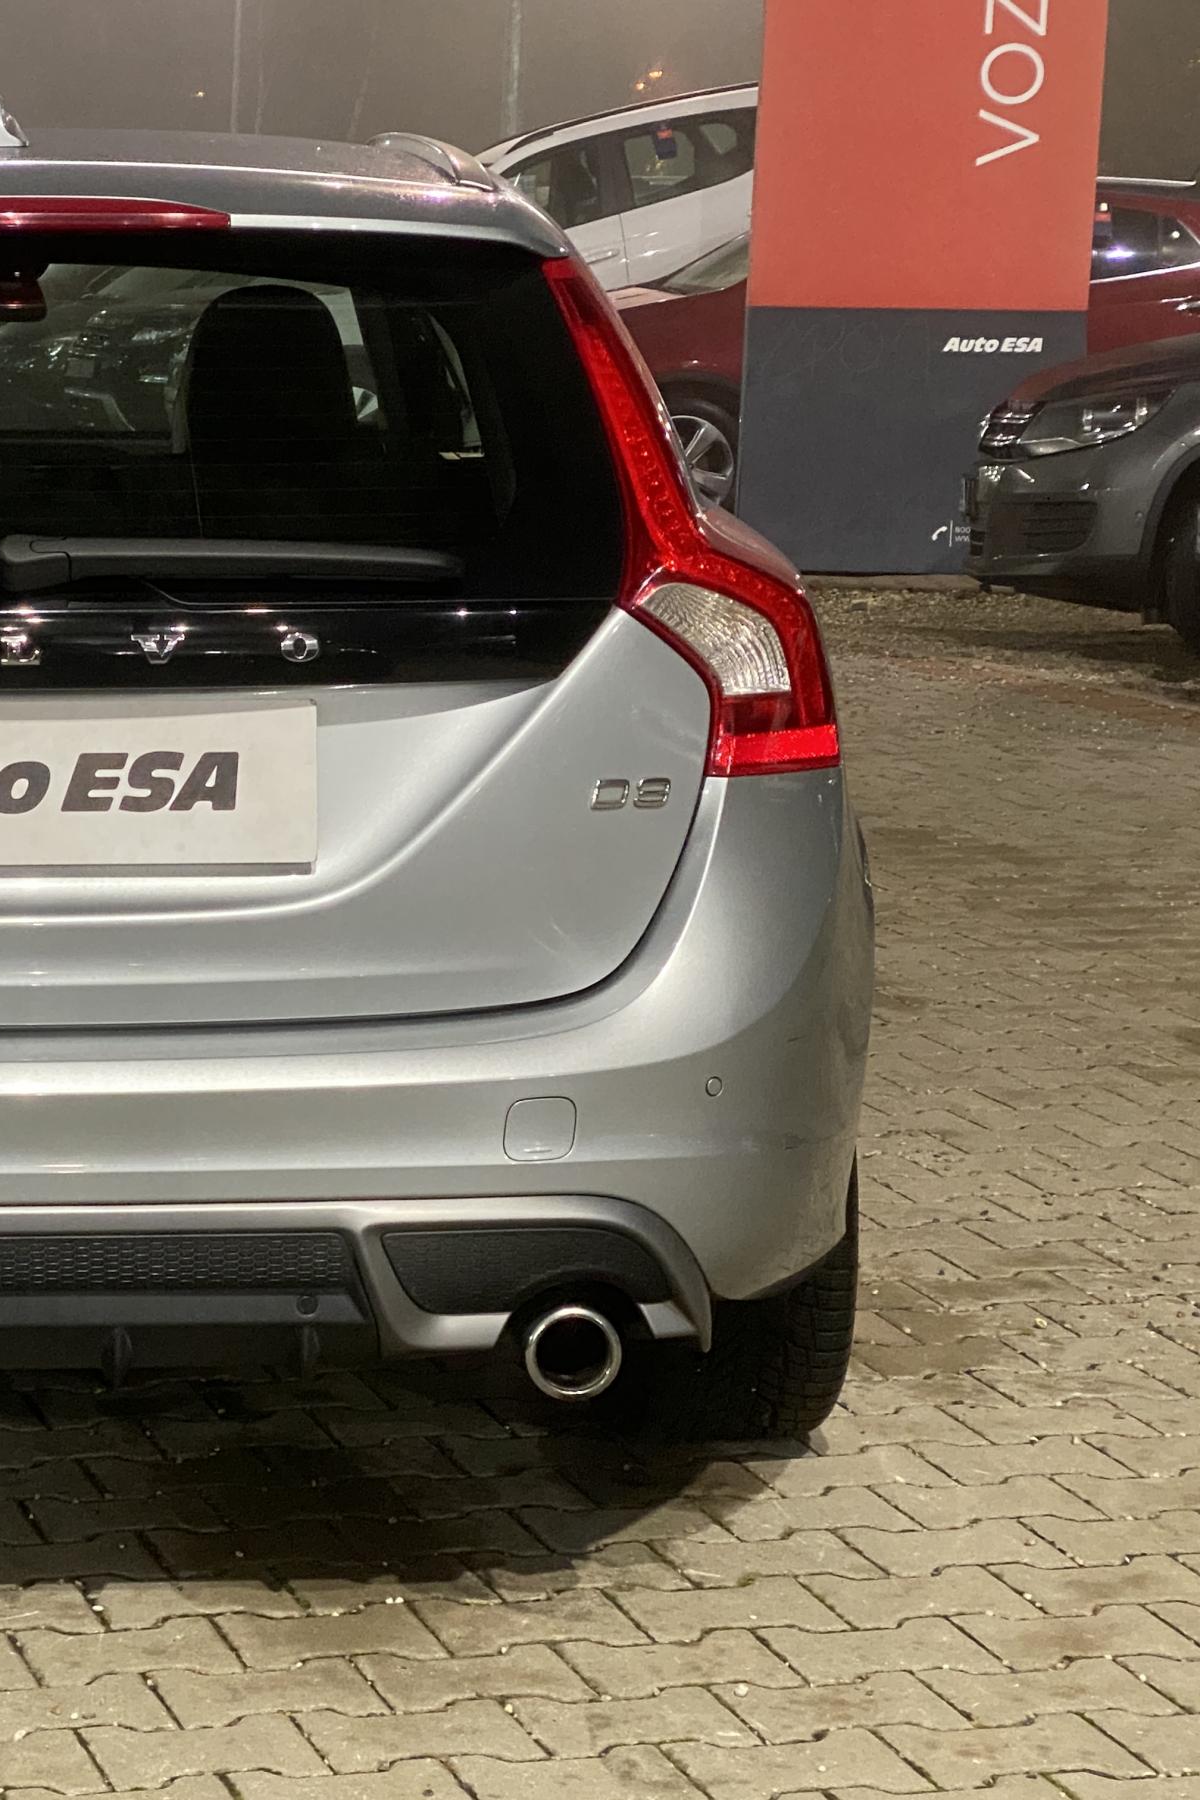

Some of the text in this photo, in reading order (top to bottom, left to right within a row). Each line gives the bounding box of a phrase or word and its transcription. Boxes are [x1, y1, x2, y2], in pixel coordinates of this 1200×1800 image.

[976, 0, 1049, 167] VOZ
[942, 336, 1043, 353] Auto ESA
[61, 751, 239, 812] ESA
